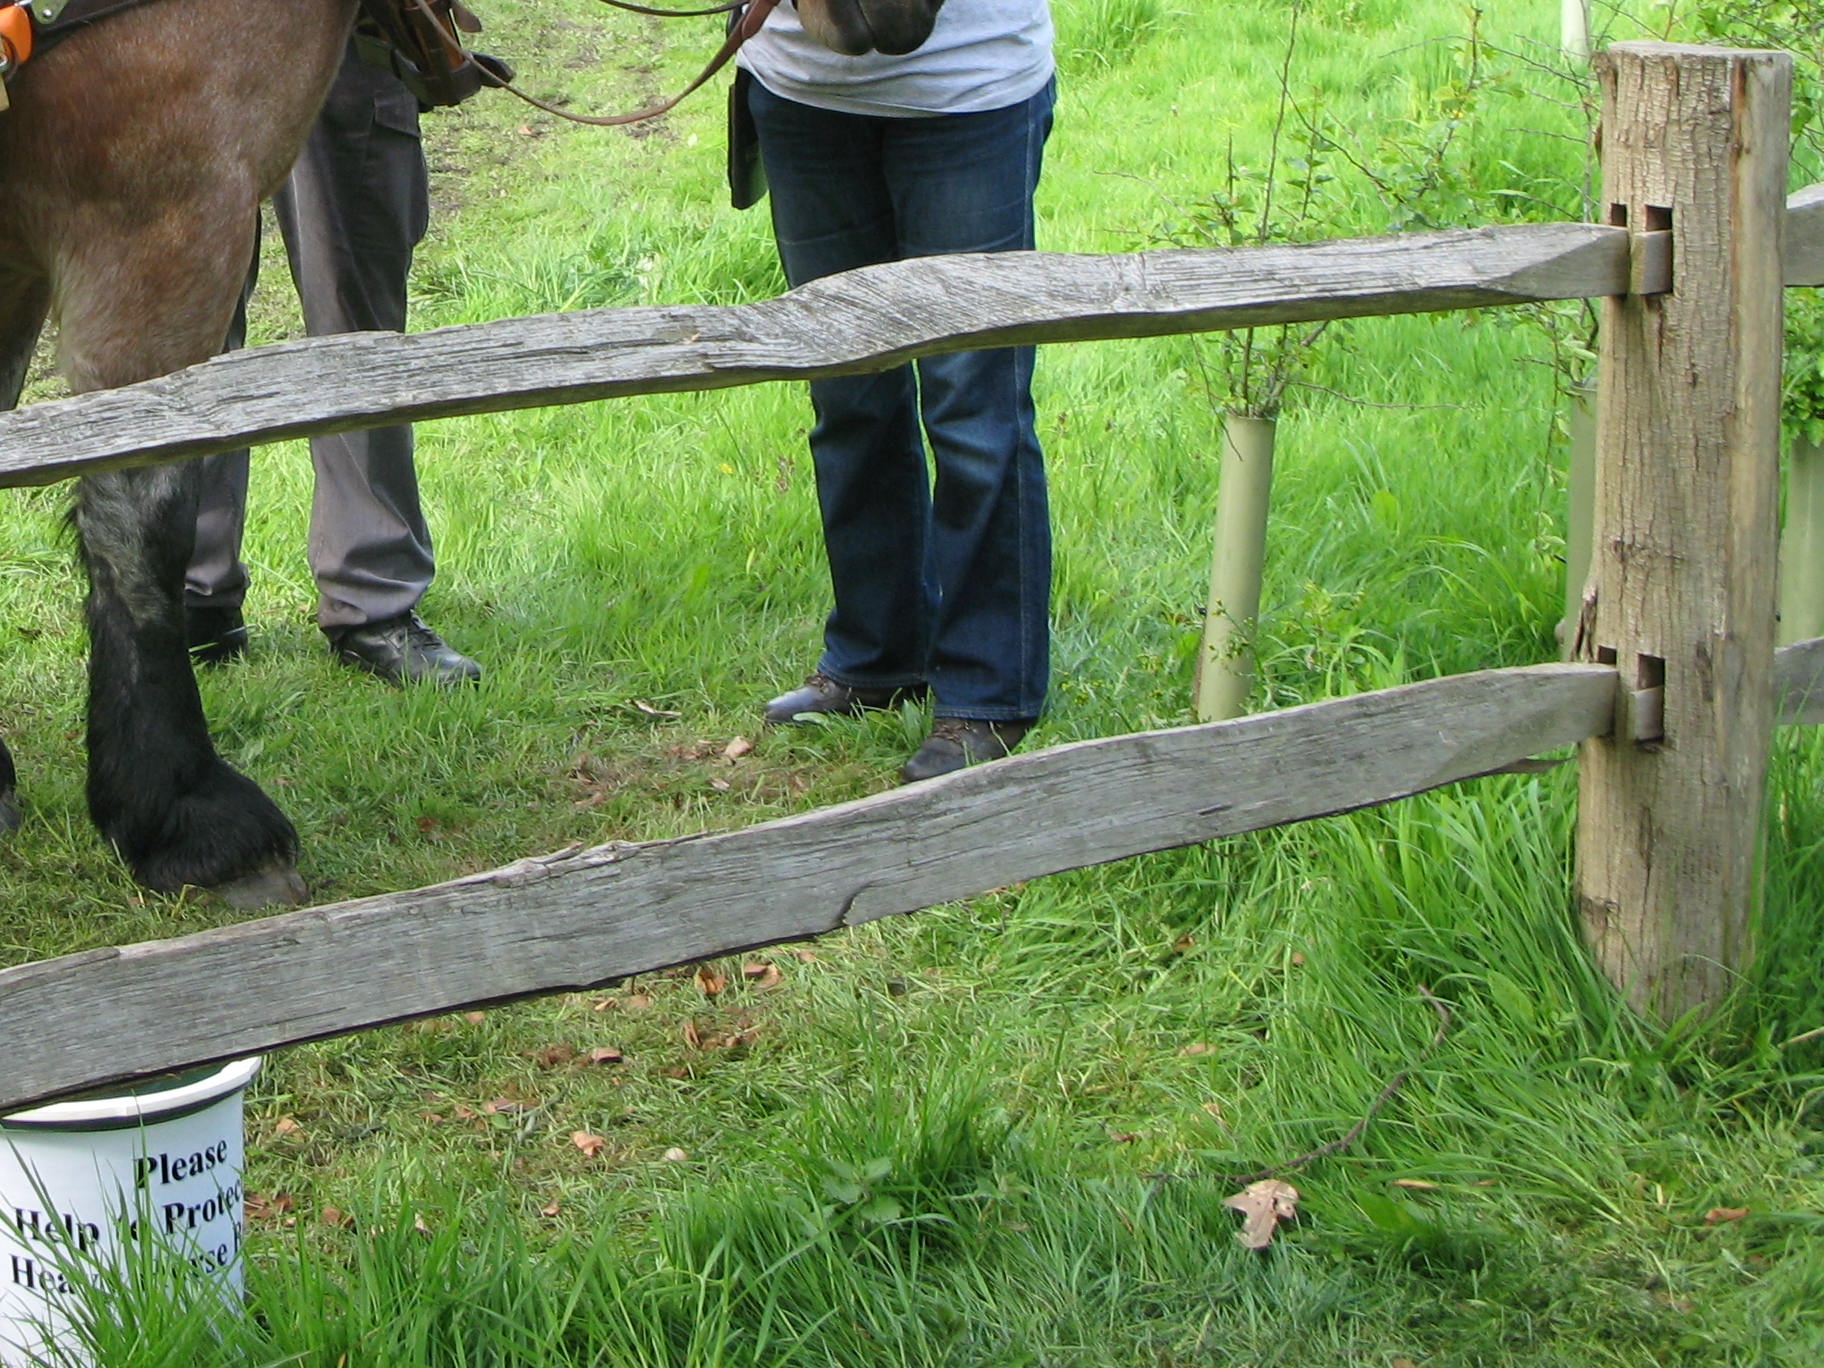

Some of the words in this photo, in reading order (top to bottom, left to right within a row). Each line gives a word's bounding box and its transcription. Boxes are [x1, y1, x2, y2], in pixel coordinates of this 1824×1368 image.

[134, 1139, 228, 1190] Please
[14, 1207, 100, 1253] Help
[162, 1178, 242, 1236] Protec
